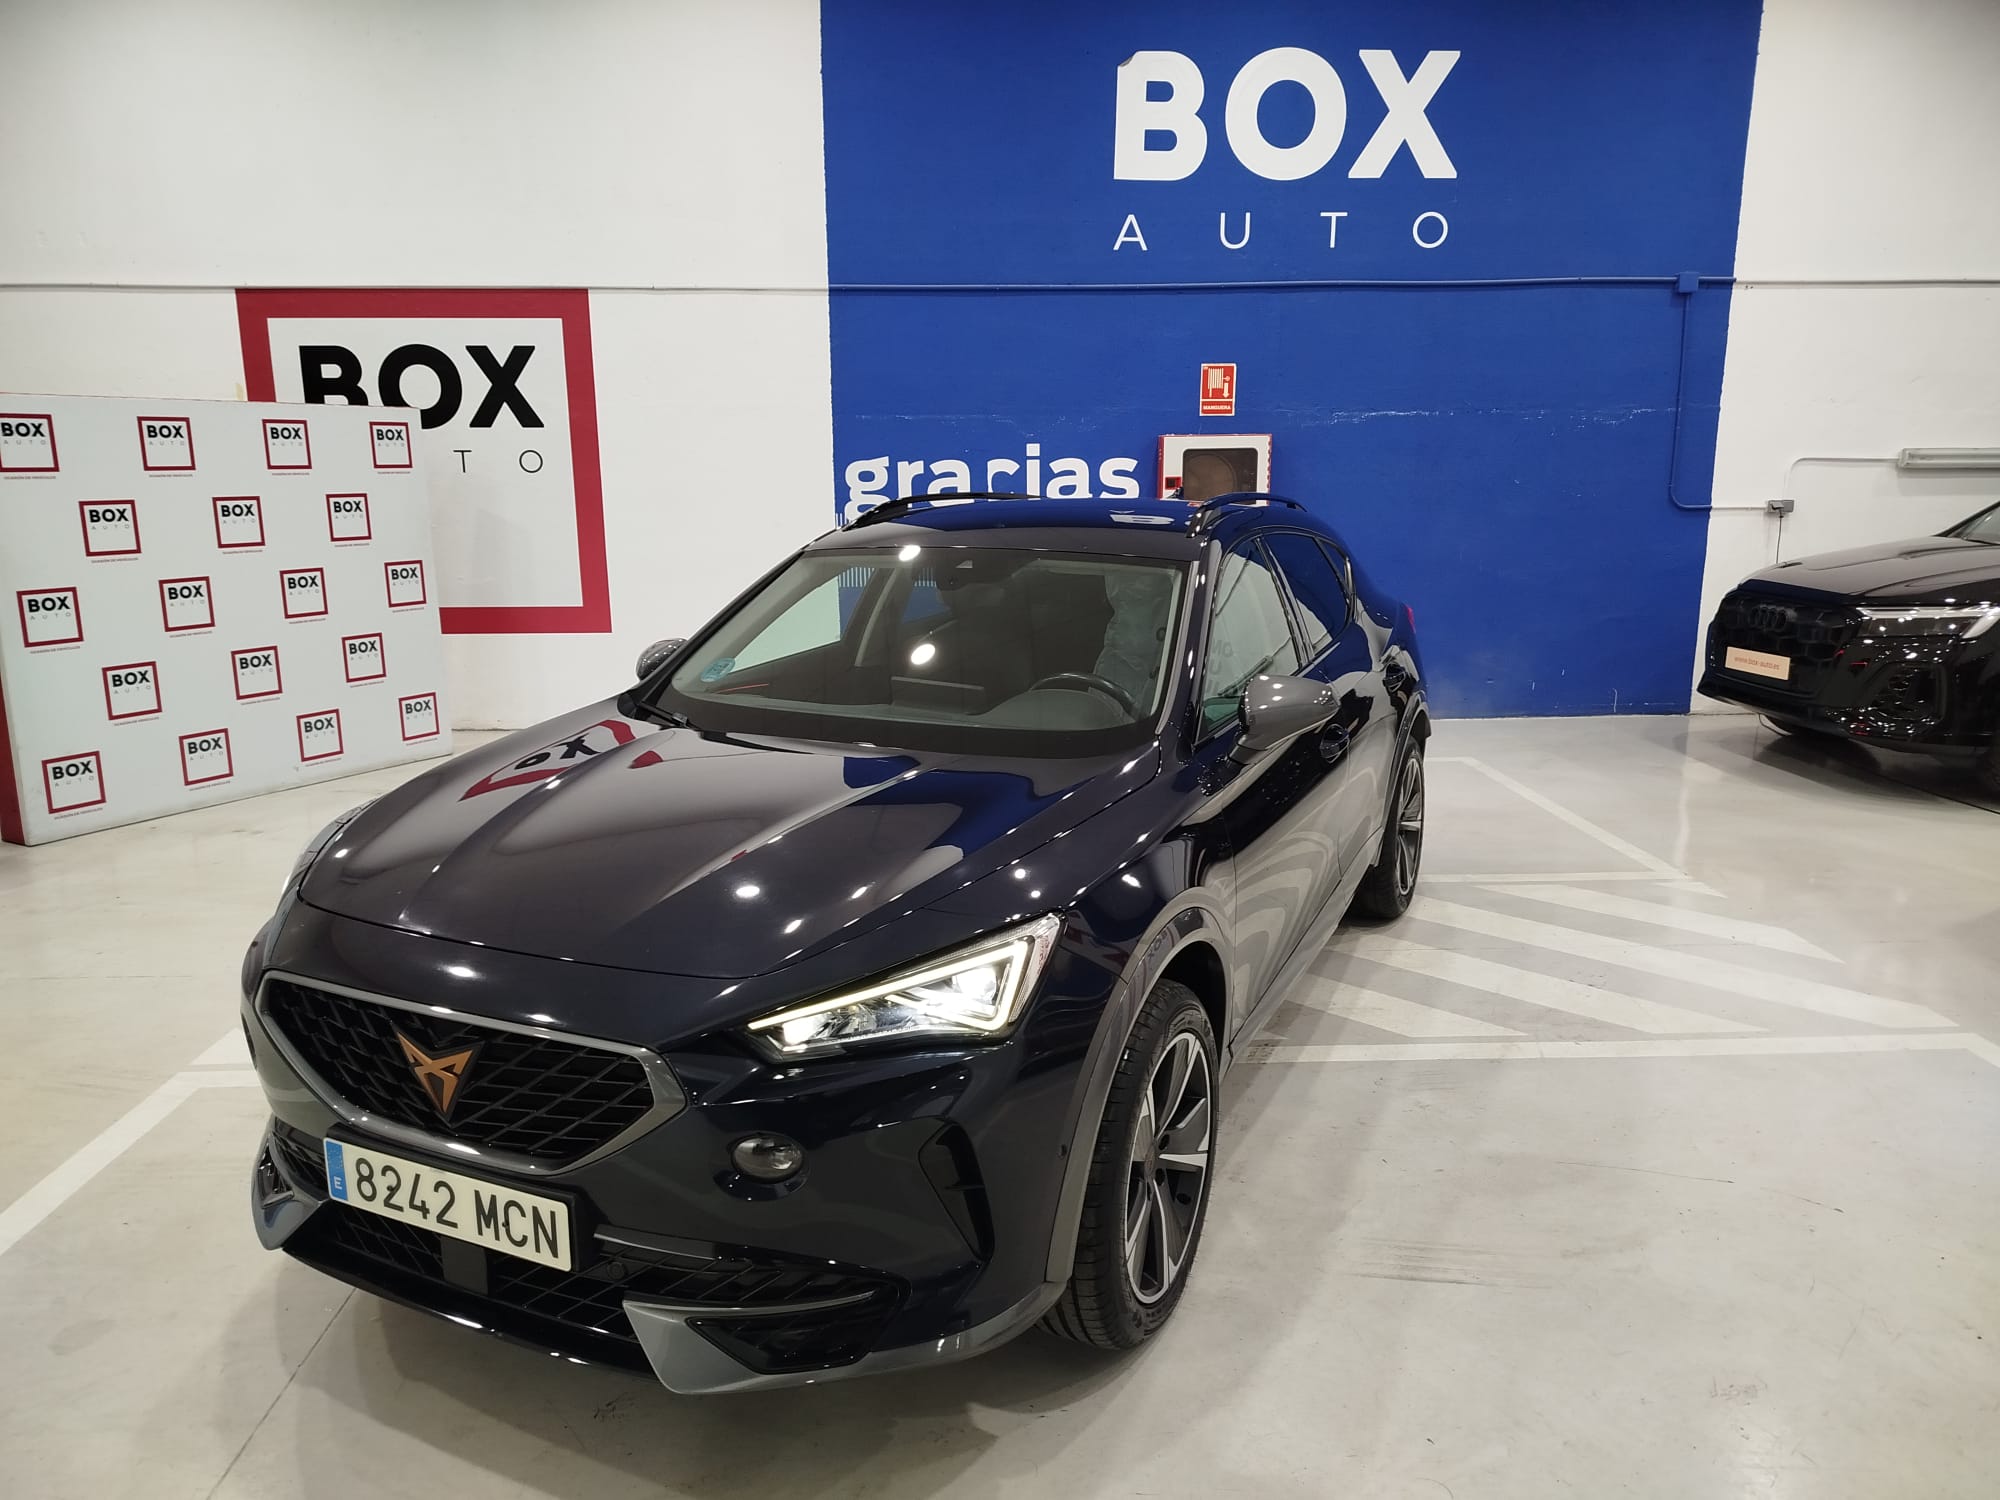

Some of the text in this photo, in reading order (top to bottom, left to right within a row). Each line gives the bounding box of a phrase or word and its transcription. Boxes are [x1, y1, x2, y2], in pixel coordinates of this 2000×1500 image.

[1114, 47, 1461, 181] BOX
[1113, 211, 1448, 251] AUTO
[299, 344, 544, 429] BOX
[1, 422, 46, 437] BOX
[147, 425, 184, 439] BOX
[270, 426, 302, 440] BOX
[376, 428, 404, 441] BOX
[845, 443, 1140, 521] gracias
[221, 503, 255, 518] BOX
[333, 500, 363, 513] BOX
[89, 508, 129, 522] BOX
[391, 567, 418, 580] BOX
[287, 575, 319, 589] BOX
[168, 585, 204, 600] BOX
[28, 596, 71, 612] BOX
[349, 640, 377, 655] BOX
[239, 653, 273, 669] BOX
[111, 670, 151, 687] BOX
[405, 699, 431, 714] BOX
[304, 717, 334, 733] BOX
[187, 737, 223, 755] BOX
[52, 760, 93, 779] BOX
[333, 1176, 343, 1190] E
[355, 1157, 559, 1259] 8242 MCN
